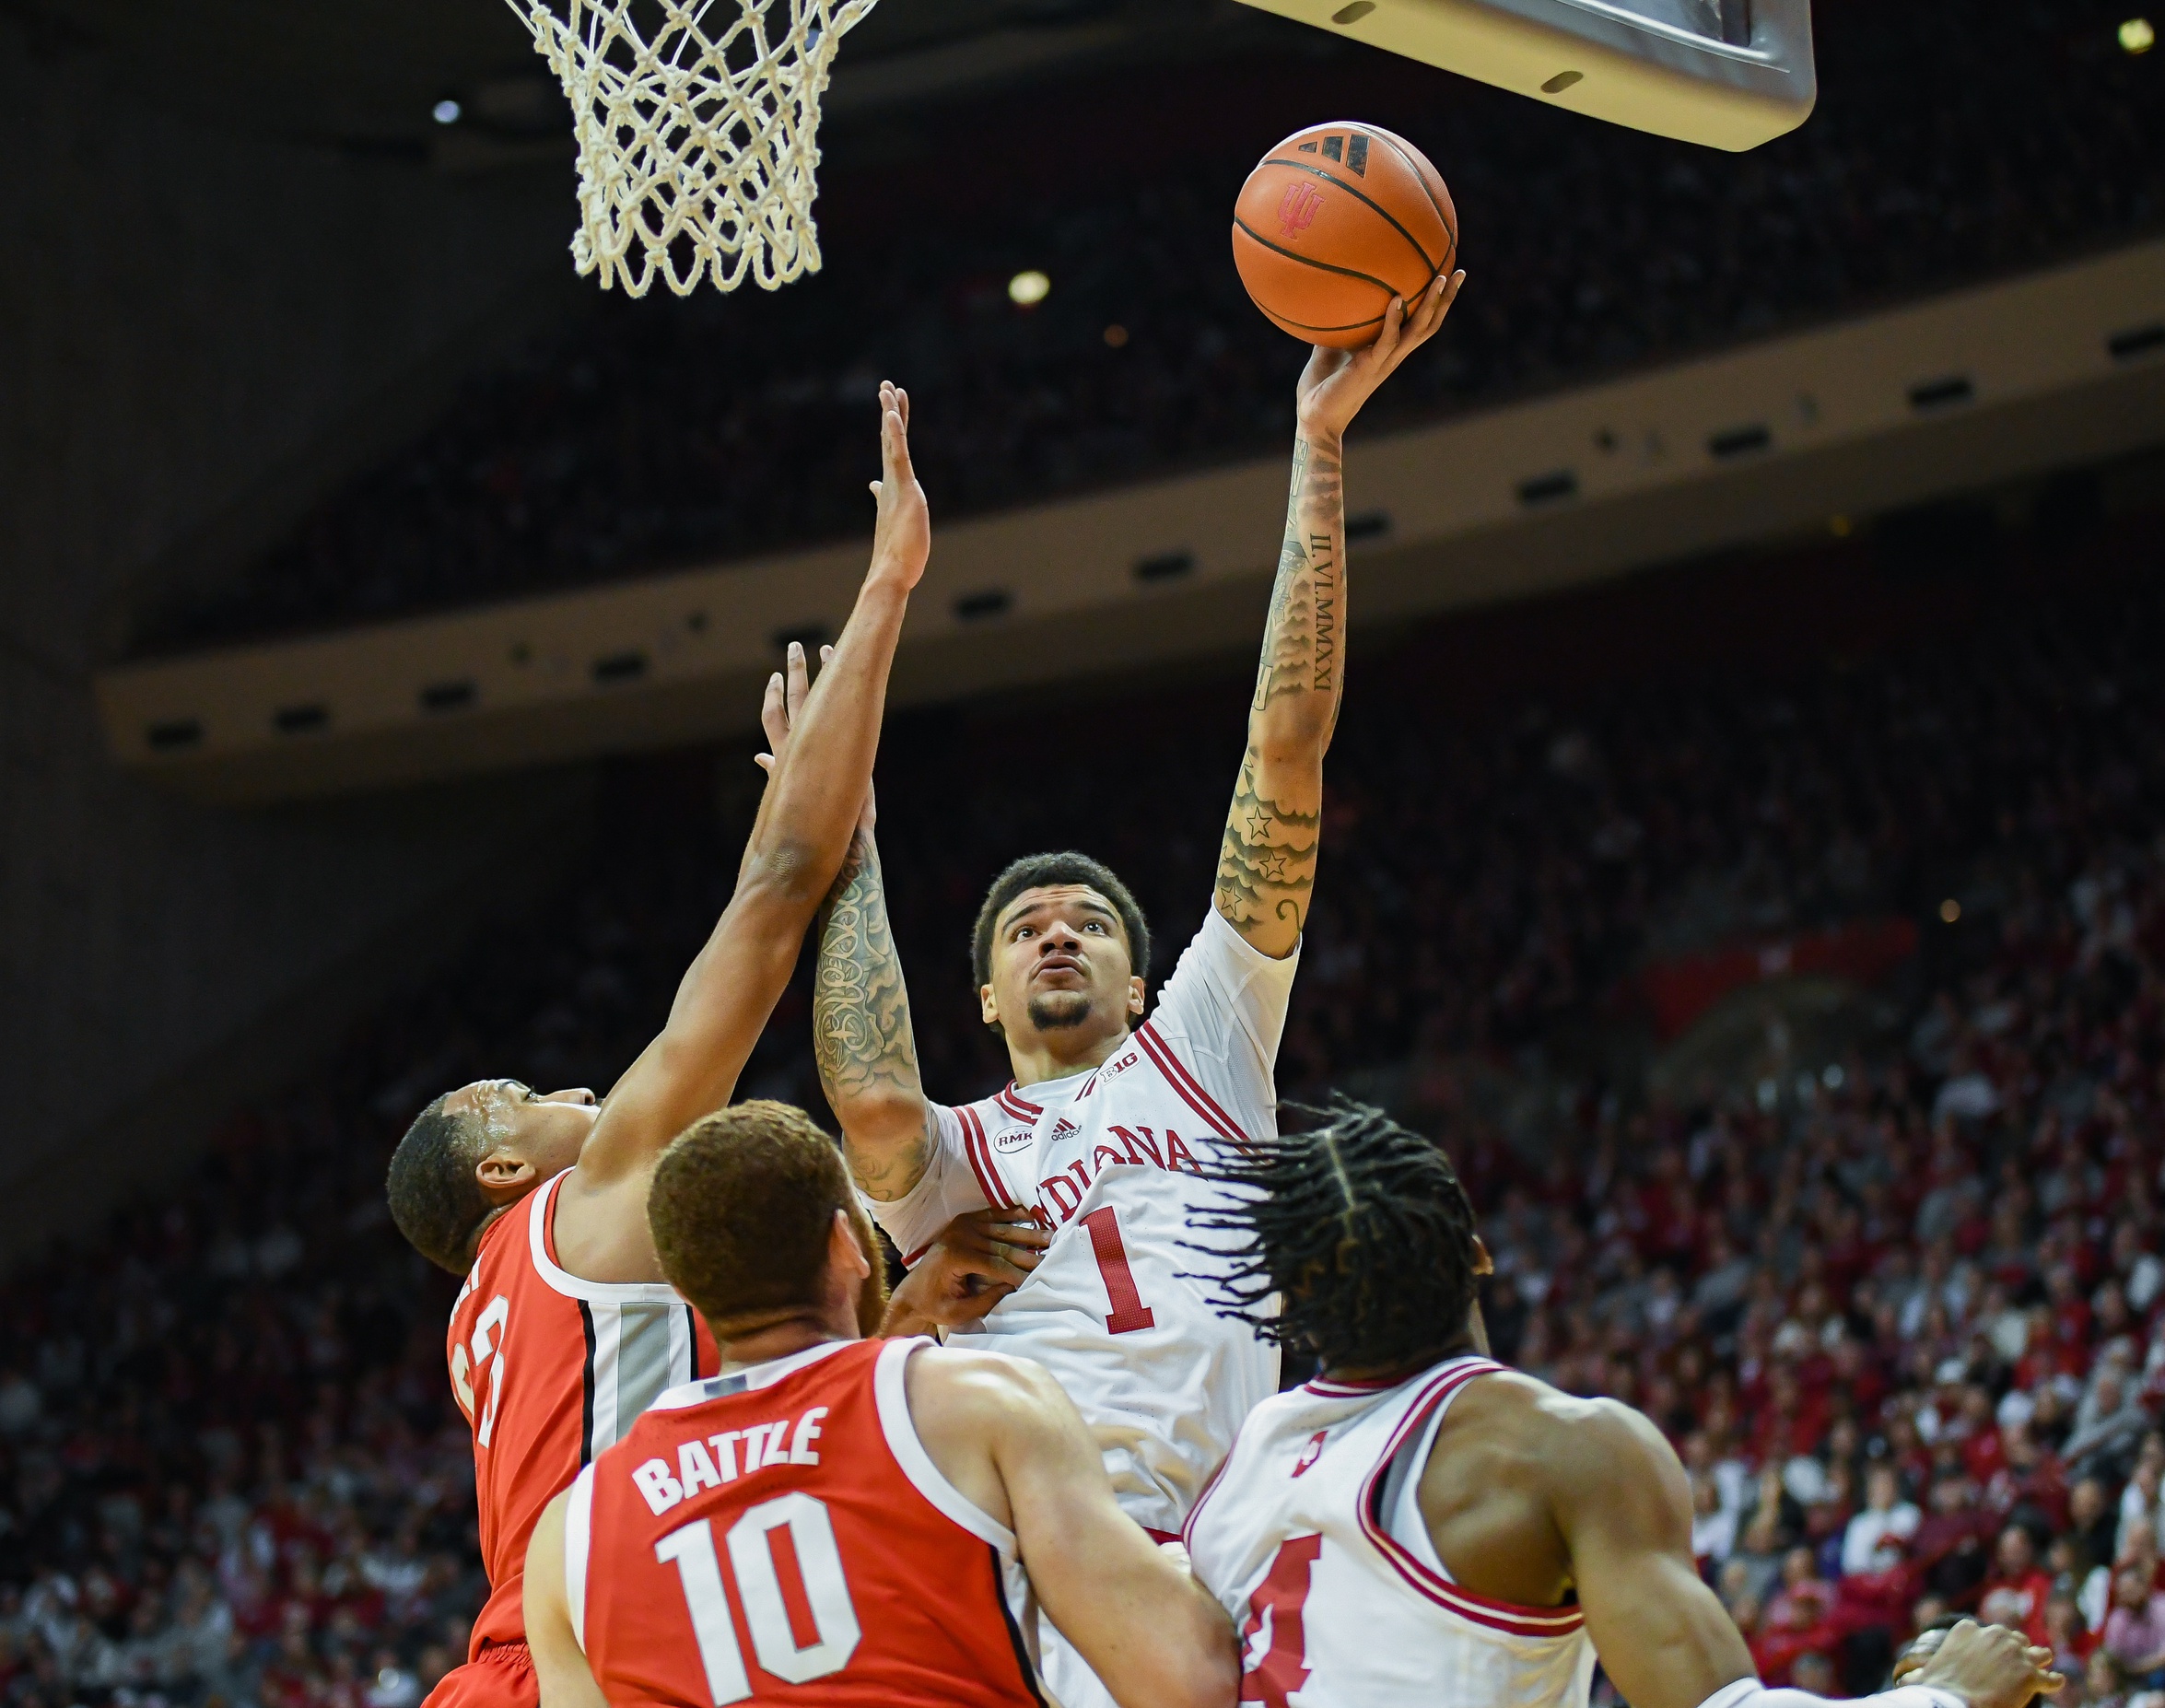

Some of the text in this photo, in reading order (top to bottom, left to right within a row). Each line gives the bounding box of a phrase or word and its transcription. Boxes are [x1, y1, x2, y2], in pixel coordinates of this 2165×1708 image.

[1026, 1125, 1210, 1242] NDIANA
[1078, 1205, 1155, 1335] 1
[631, 1406, 829, 1515] BATTLE
[654, 1491, 862, 1707] 10
